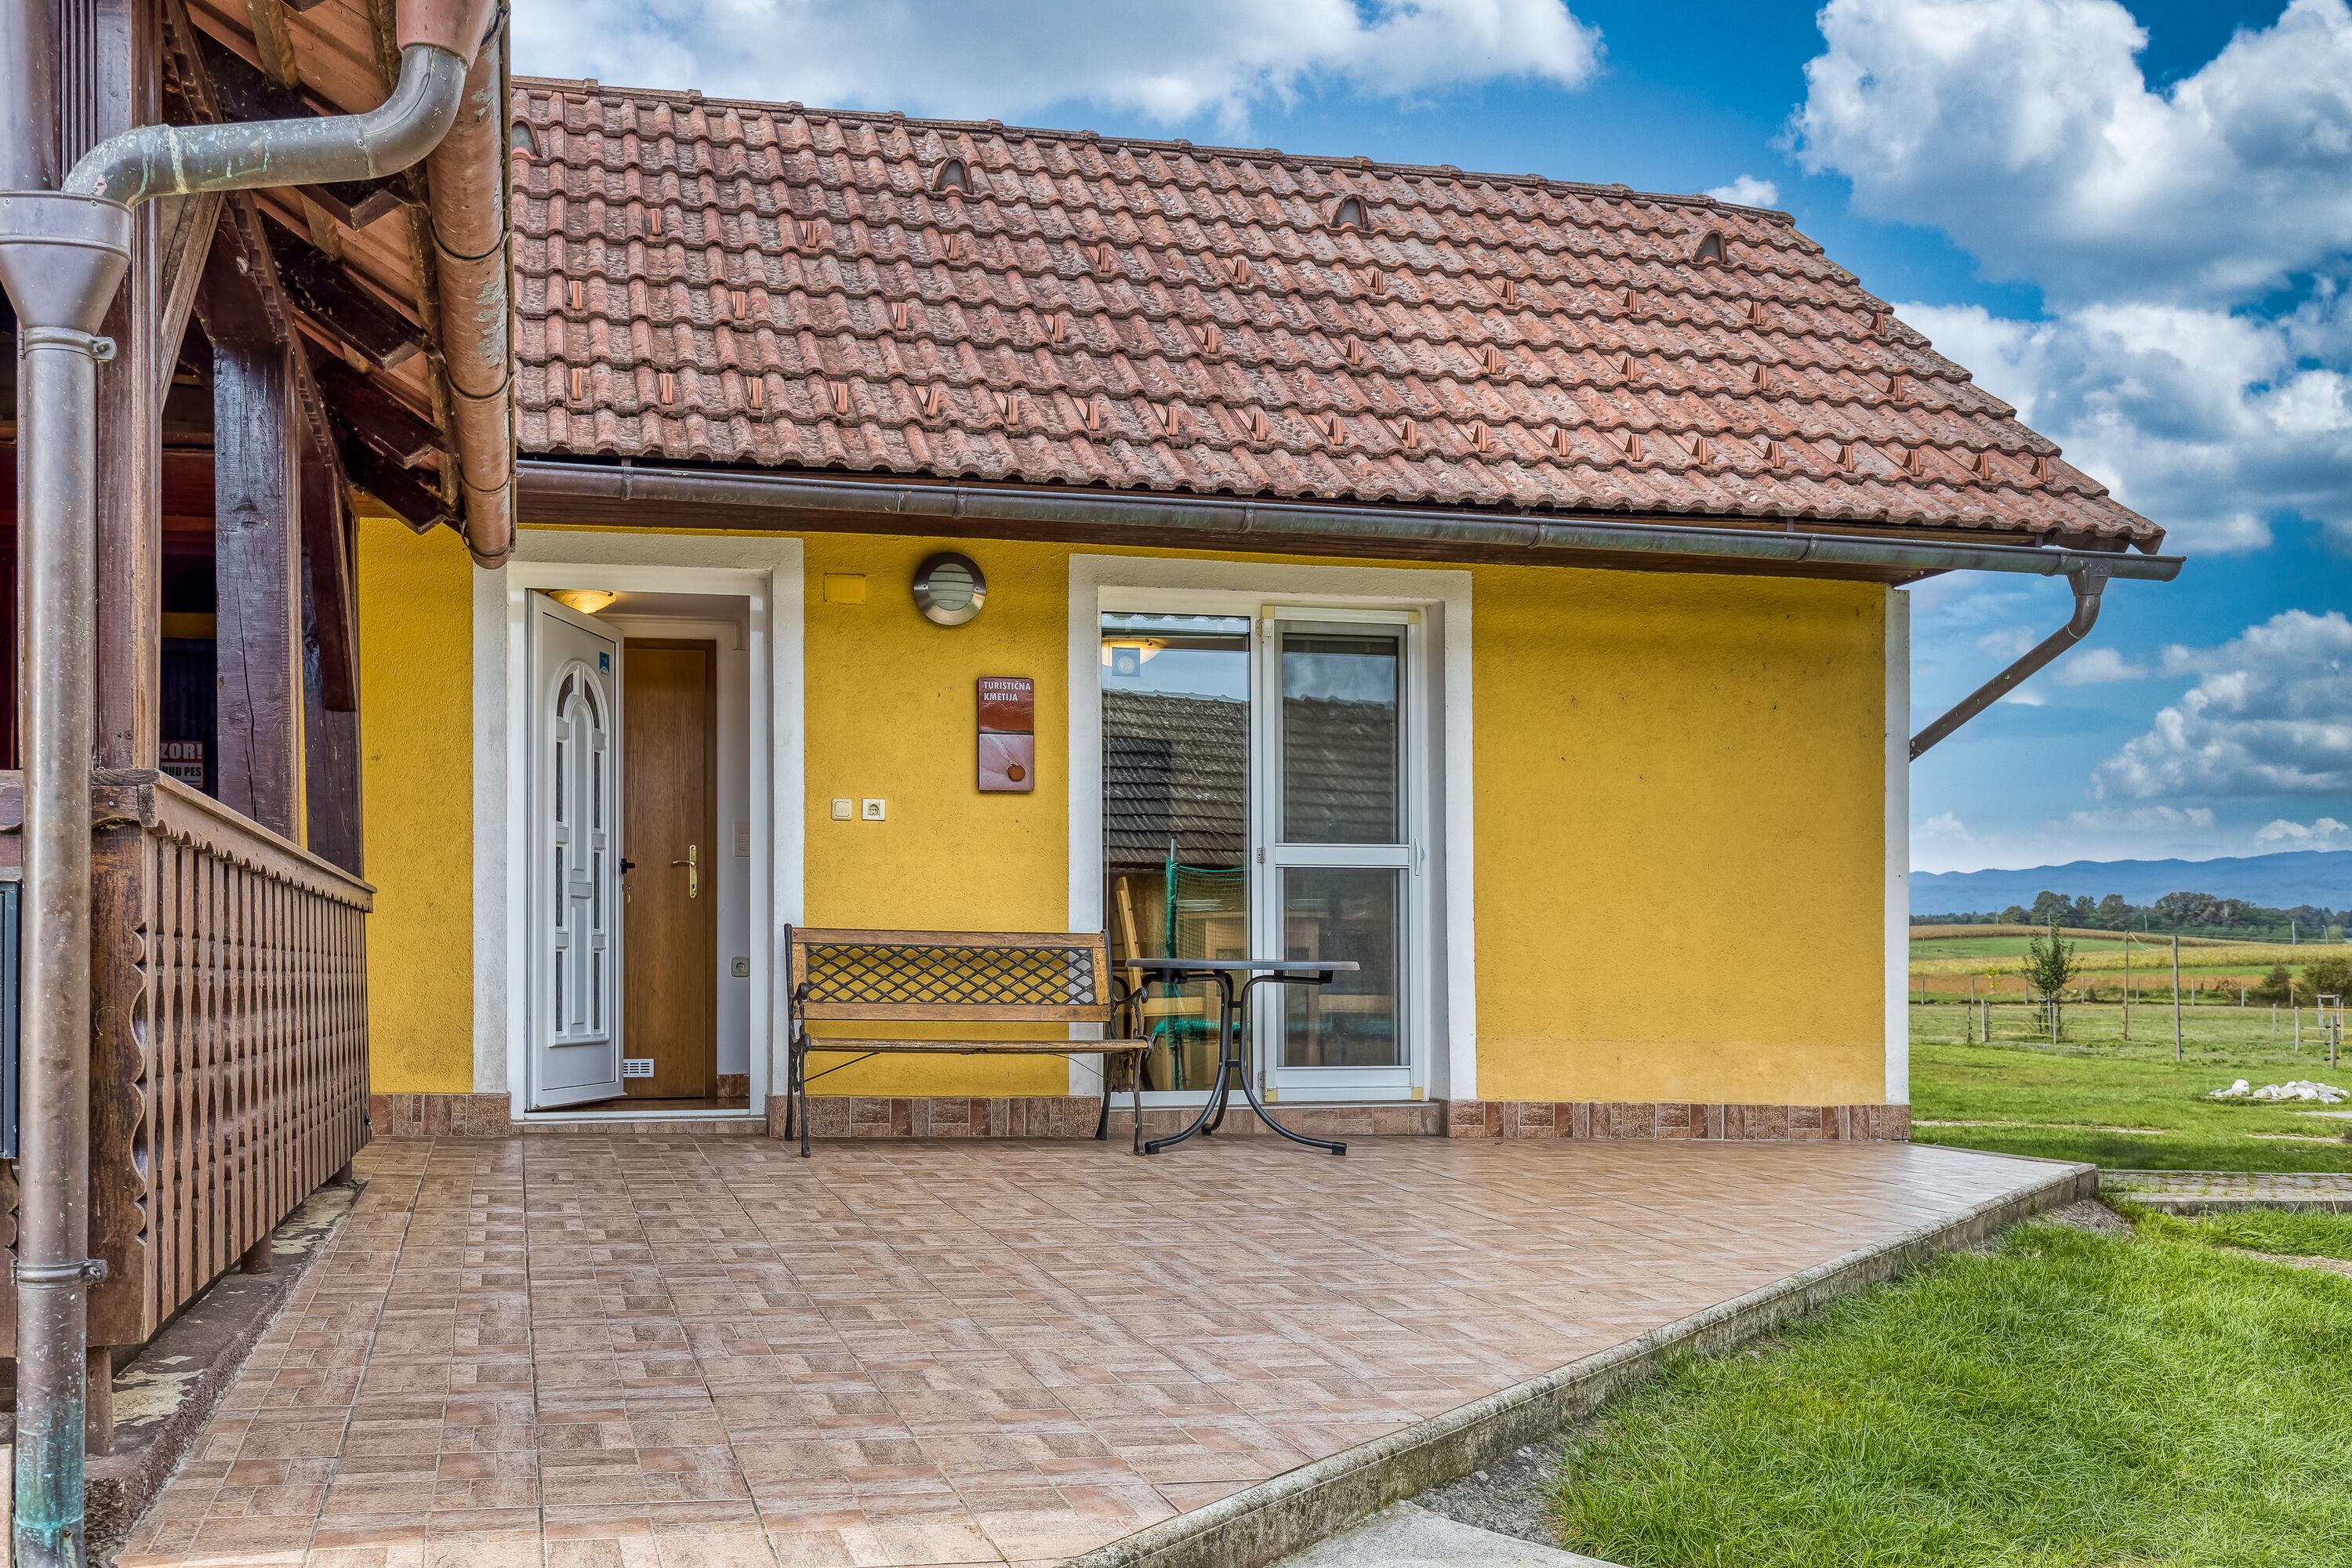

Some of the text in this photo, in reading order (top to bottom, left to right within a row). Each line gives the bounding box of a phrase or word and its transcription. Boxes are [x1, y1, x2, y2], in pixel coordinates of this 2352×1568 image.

[984, 681, 1031, 690] TURISTIČNA
[984, 692, 1018, 702] KMETIJA
[184, 766, 201, 776] PES
